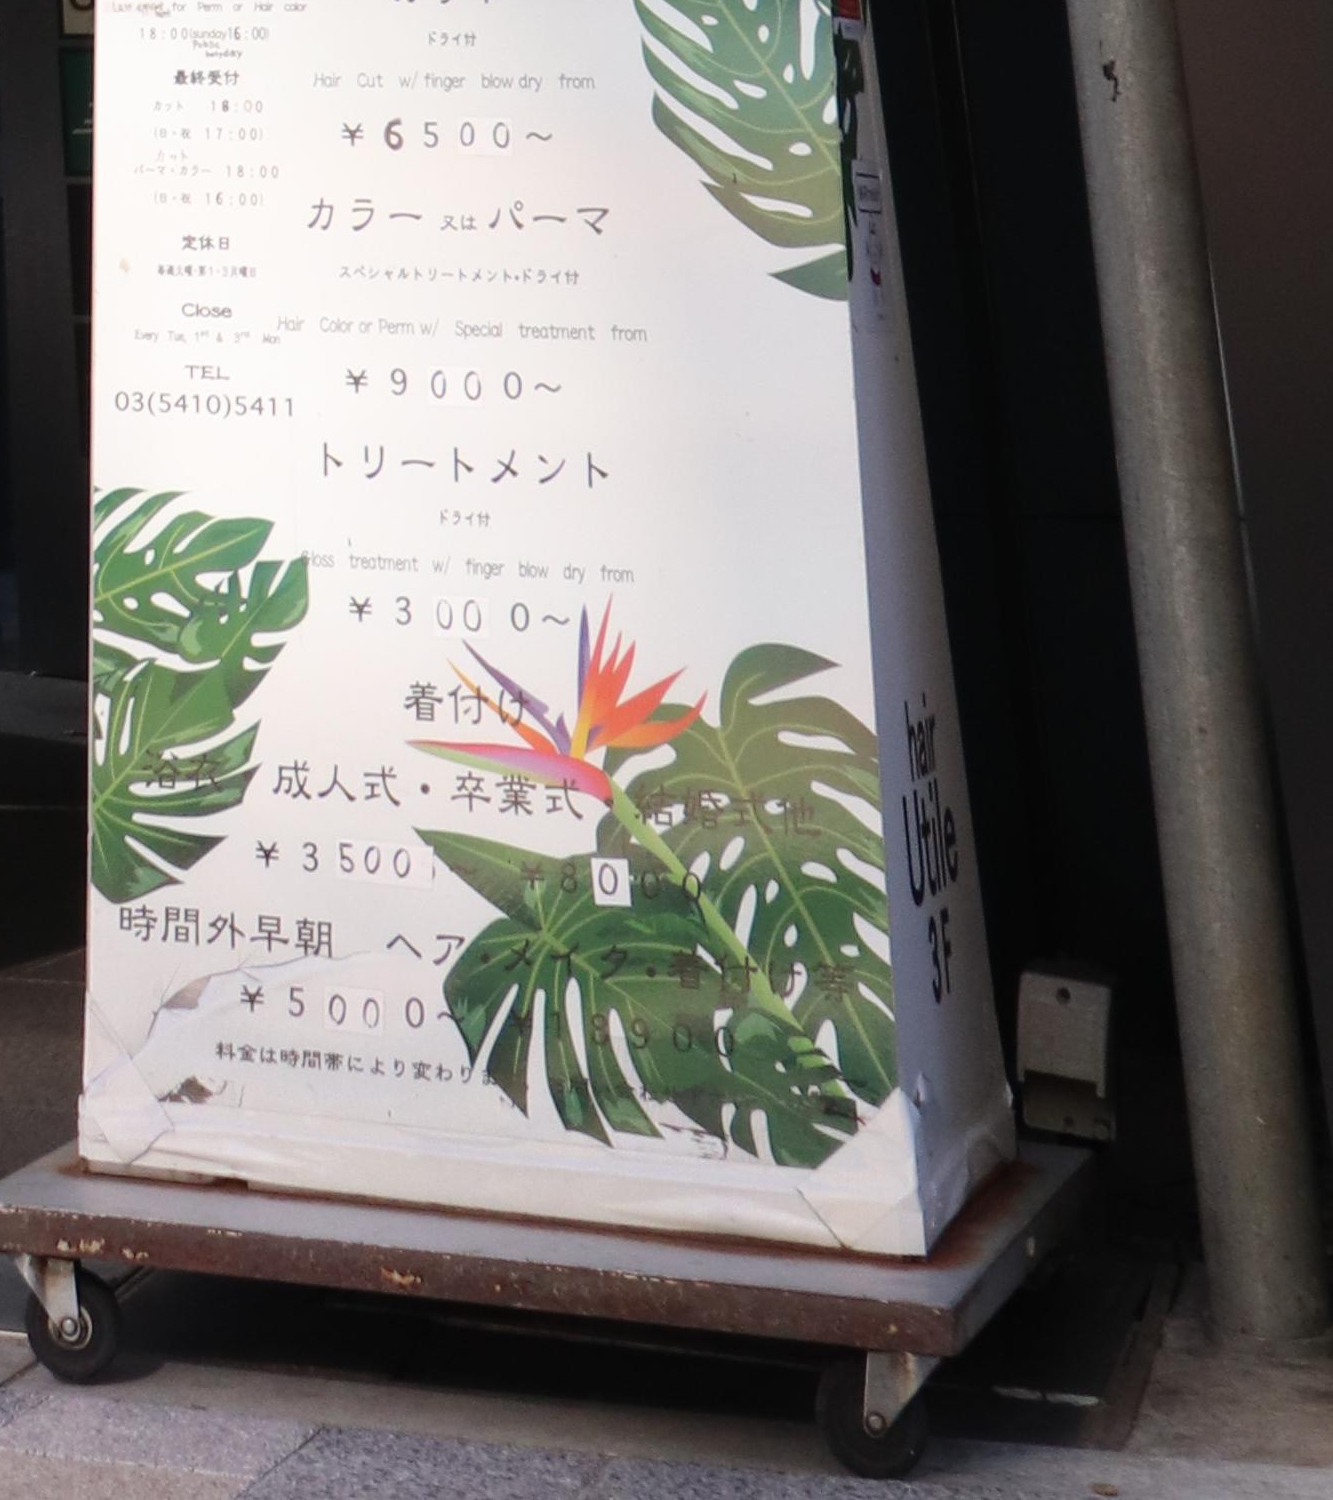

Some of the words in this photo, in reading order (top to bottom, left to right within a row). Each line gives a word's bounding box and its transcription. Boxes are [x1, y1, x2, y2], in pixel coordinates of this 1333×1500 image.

[312, 72, 342, 89] Hair
[356, 72, 385, 89] Cut
[424, 72, 467, 93] finger
[480, 72, 514, 90] blow
[519, 74, 544, 93] dry
[559, 73, 596, 91] from
[181, 235, 230, 251] 定休日
[180, 302, 234, 319] Close
[276, 315, 306, 333] Hair
[318, 315, 355, 334] Color
[357, 320, 374, 335] or
[377, 317, 417, 336] Perm
[454, 319, 505, 339] Special
[517, 322, 596, 342] treatment
[610, 324, 649, 343] from
[183, 364, 231, 382] TEL
[114, 390, 295, 419] 03(5410)5411
[322, 441, 610, 489] トリートメント
[348, 552, 420, 573] treatment
[465, 557, 506, 580] finger
[518, 559, 550, 579] blow
[562, 561, 586, 584] dry
[600, 563, 635, 583] from
[402, 680, 525, 726] 着付け
[904, 691, 937, 782] hair
[901, 777, 960, 907] Utile
[118, 903, 335, 960] 時間外早朝
